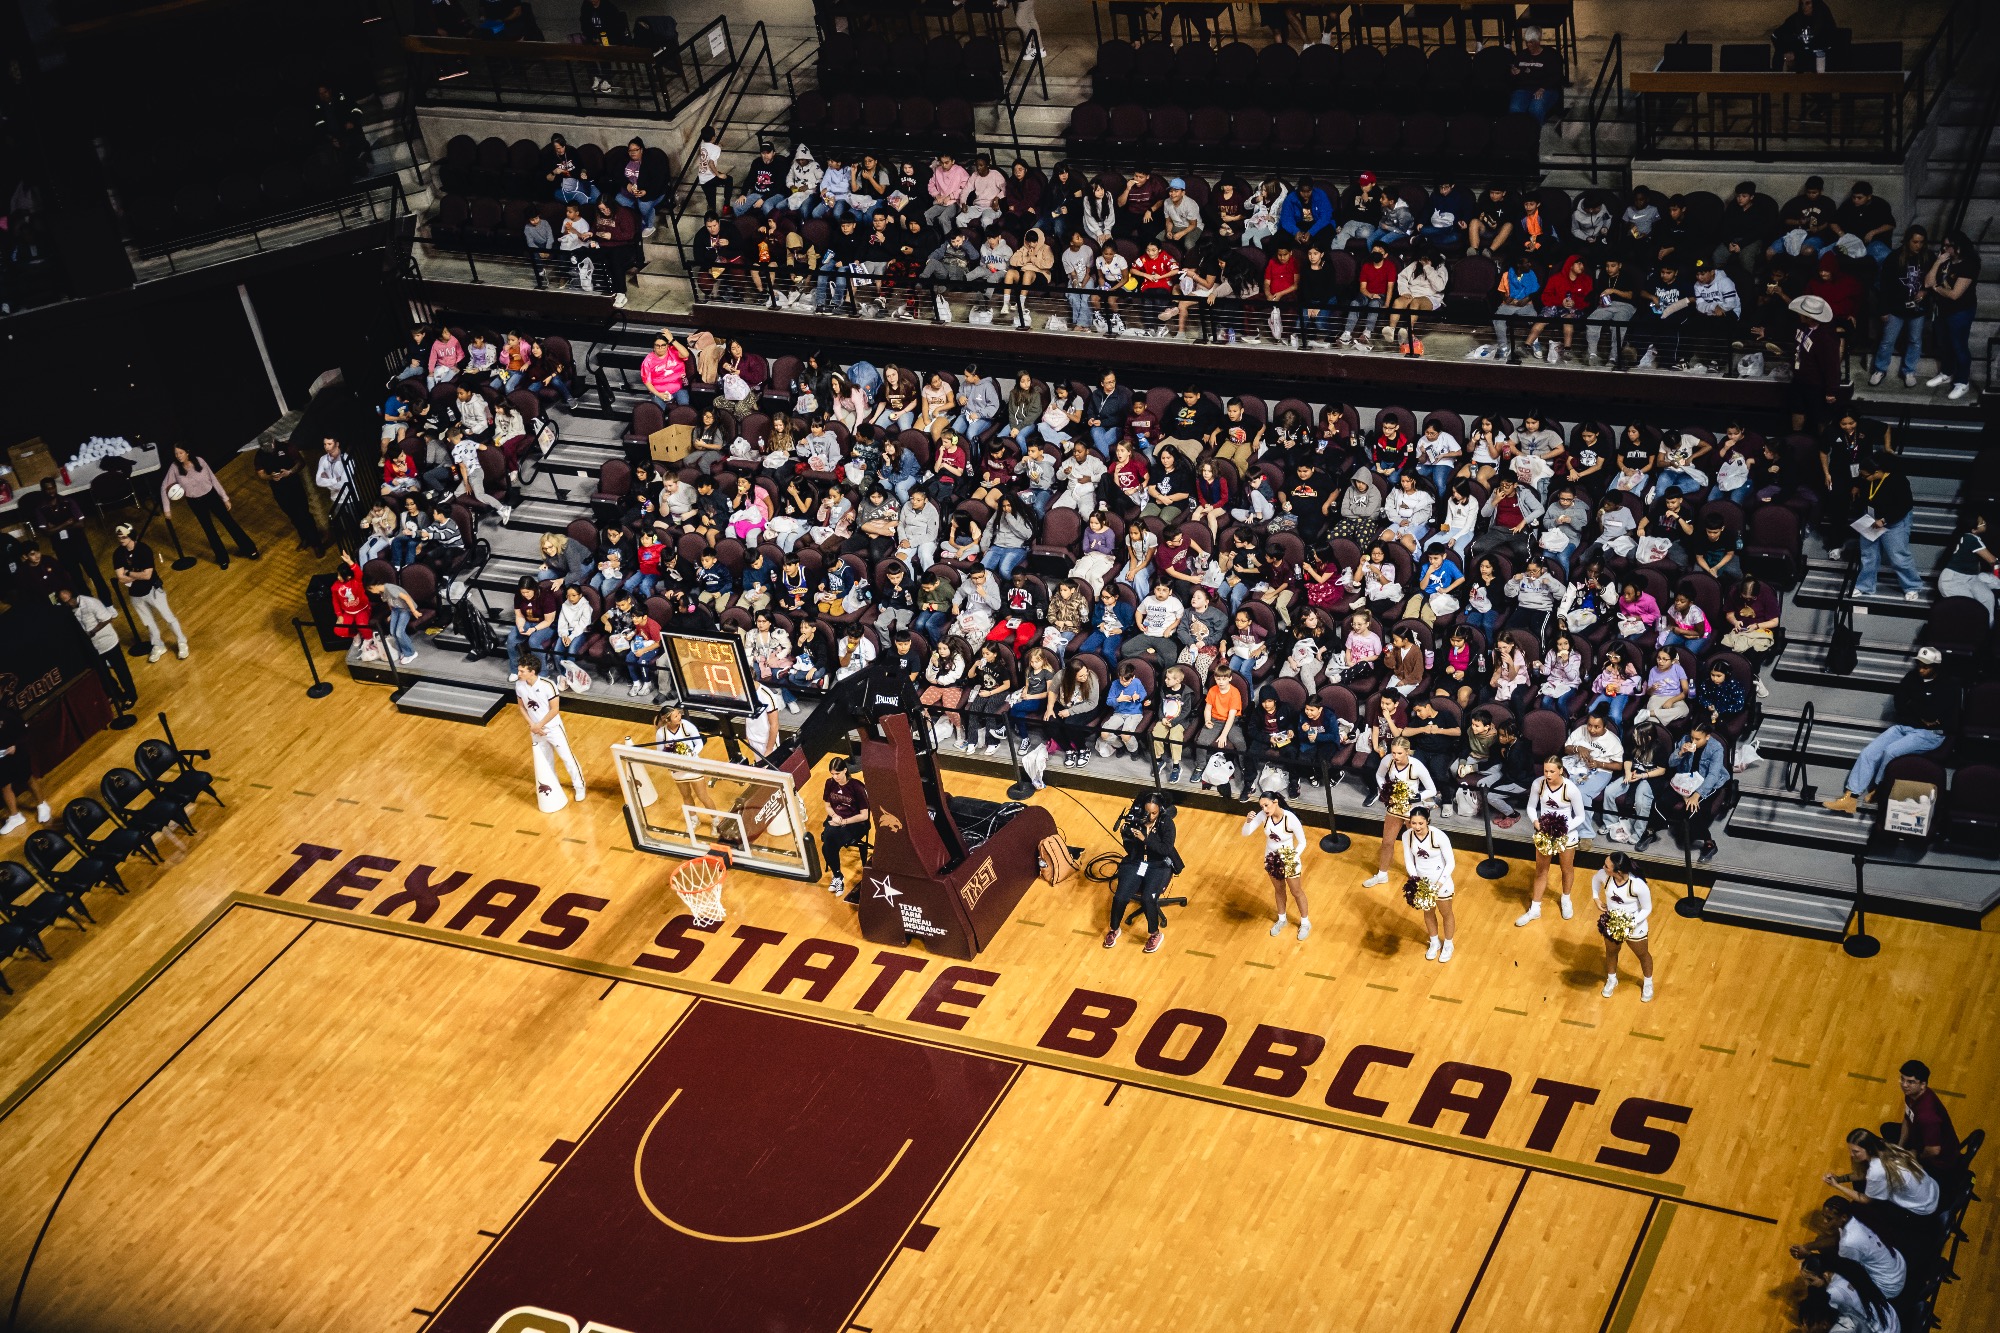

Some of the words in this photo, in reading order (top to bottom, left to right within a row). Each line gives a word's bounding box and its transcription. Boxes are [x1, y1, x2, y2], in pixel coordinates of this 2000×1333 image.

[438, 348, 458, 357] GAP
[703, 664, 738, 698] 19
[16, 667, 62, 709] STATE
[875, 694, 898, 707] SPALDING
[960, 855, 997, 910] TXST
[899, 903, 922, 913] TEXAS
[901, 910, 921, 919] FARM
[902, 916, 931, 926] BUREAU
[903, 922, 946, 935] INSURANCE
[263, 841, 610, 951] TEXAS
[632, 914, 1000, 1031] STATE
[1036, 987, 1694, 1176] BOBCATS
